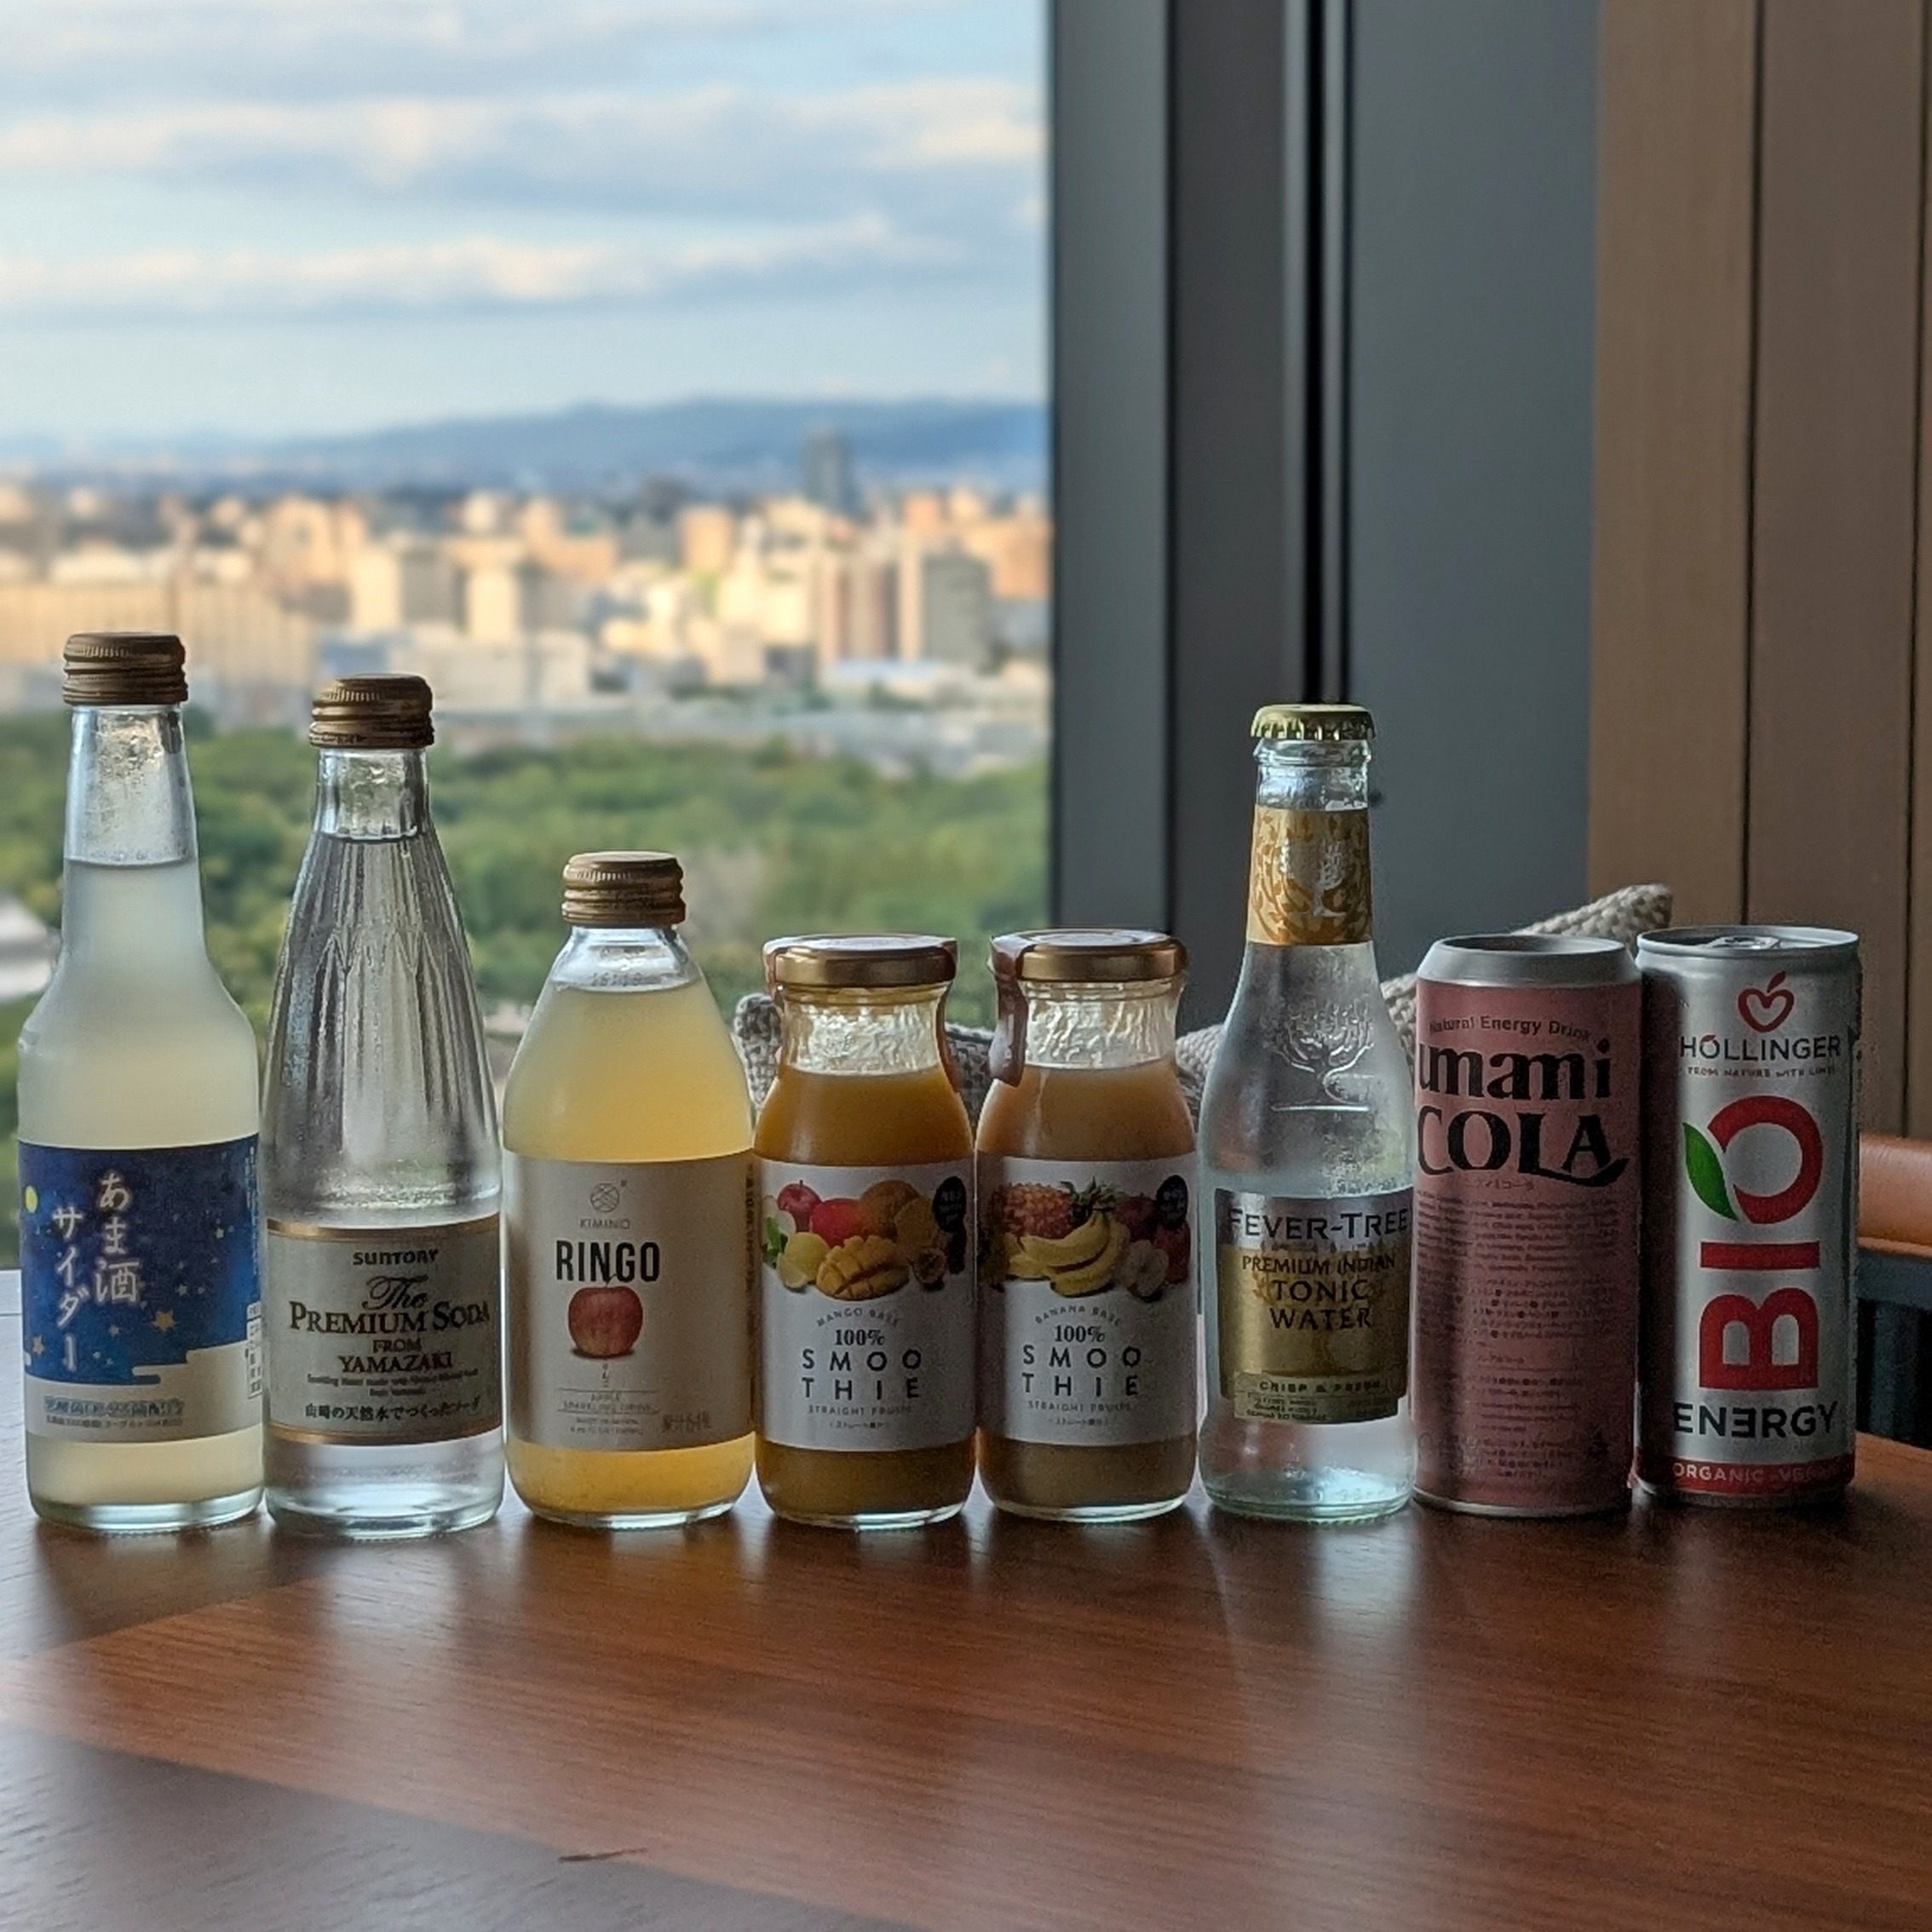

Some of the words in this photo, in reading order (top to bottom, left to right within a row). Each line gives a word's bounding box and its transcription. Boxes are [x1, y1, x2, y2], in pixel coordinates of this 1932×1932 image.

[1481, 1015, 1541, 1035] Energy
[1549, 1021, 1591, 1042] Drink
[1418, 1038, 1612, 1101] umami
[1417, 1105, 1630, 1187] COLA
[579, 1218, 631, 1230] KIMINO
[1229, 1207, 1408, 1239] FEVER-TREE
[94, 1172, 141, 1304] あま酒
[1684, 1095, 1823, 1391] BIO
[555, 1239, 661, 1283] RINGO
[1241, 1255, 1330, 1276] PREMIUM
[1337, 1253, 1396, 1275] INDIAN
[52, 1205, 89, 1372] サイダー
[361, 1275, 429, 1311] The
[1270, 1279, 1369, 1302] TONIC
[289, 1301, 426, 1335] PREMIUM
[815, 1307, 863, 1328] MANGO
[1034, 1304, 1086, 1325] BANANA
[1268, 1307, 1372, 1331] WATER
[372, 1338, 423, 1354] FROM
[834, 1328, 886, 1347] 100%
[1054, 1325, 1106, 1344] 100%
[337, 1350, 453, 1373] YAMAZAKI
[802, 1348, 923, 1372] SMOO
[801, 1376, 921, 1401] THIE
[1021, 1371, 1139, 1398] THIE
[1673, 1463, 1764, 1485] ORGANIC
